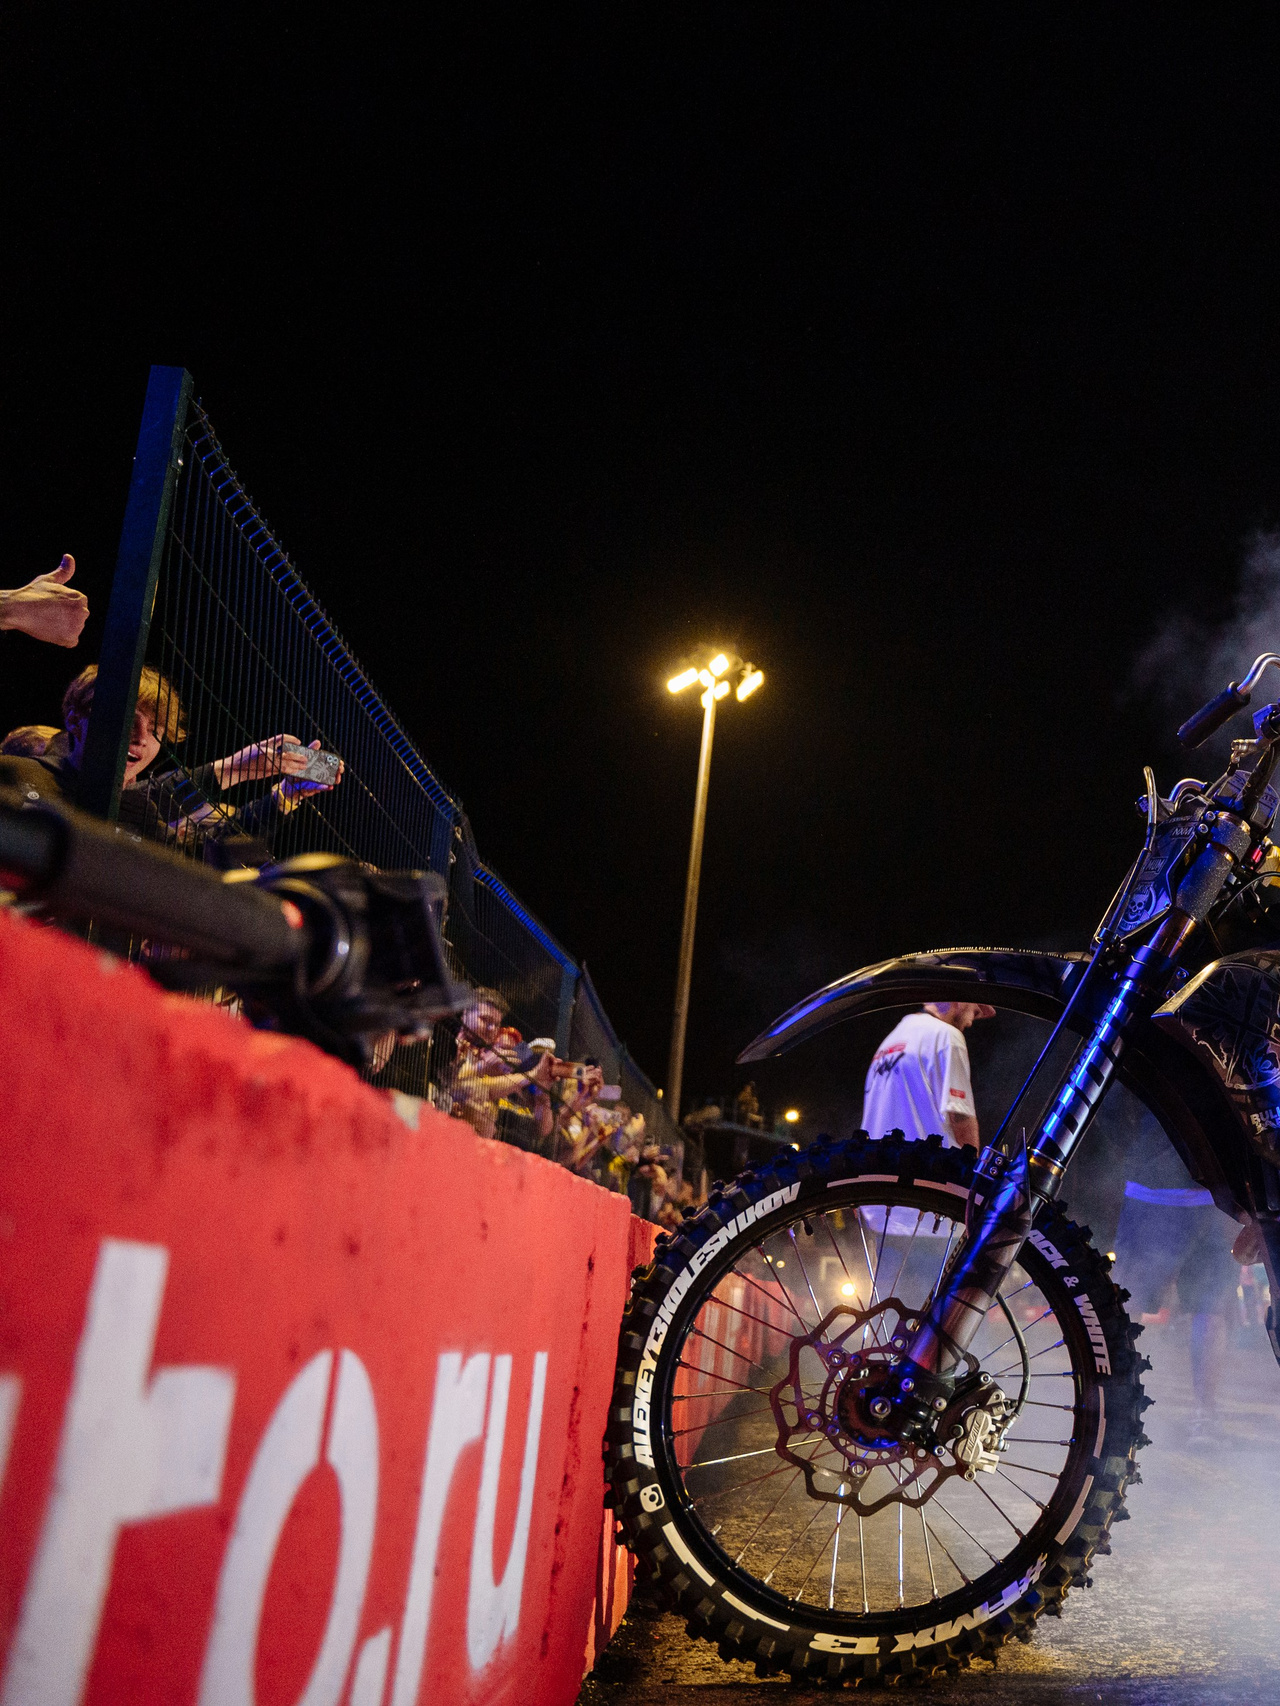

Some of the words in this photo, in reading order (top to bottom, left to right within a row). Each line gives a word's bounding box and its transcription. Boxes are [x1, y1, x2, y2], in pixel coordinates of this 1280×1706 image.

[1063, 1276, 1080, 1288] &
[1073, 1293, 1112, 1376] WHITE
[0, 1237, 549, 1706] to.ru
[808, 1631, 880, 1655] 13
